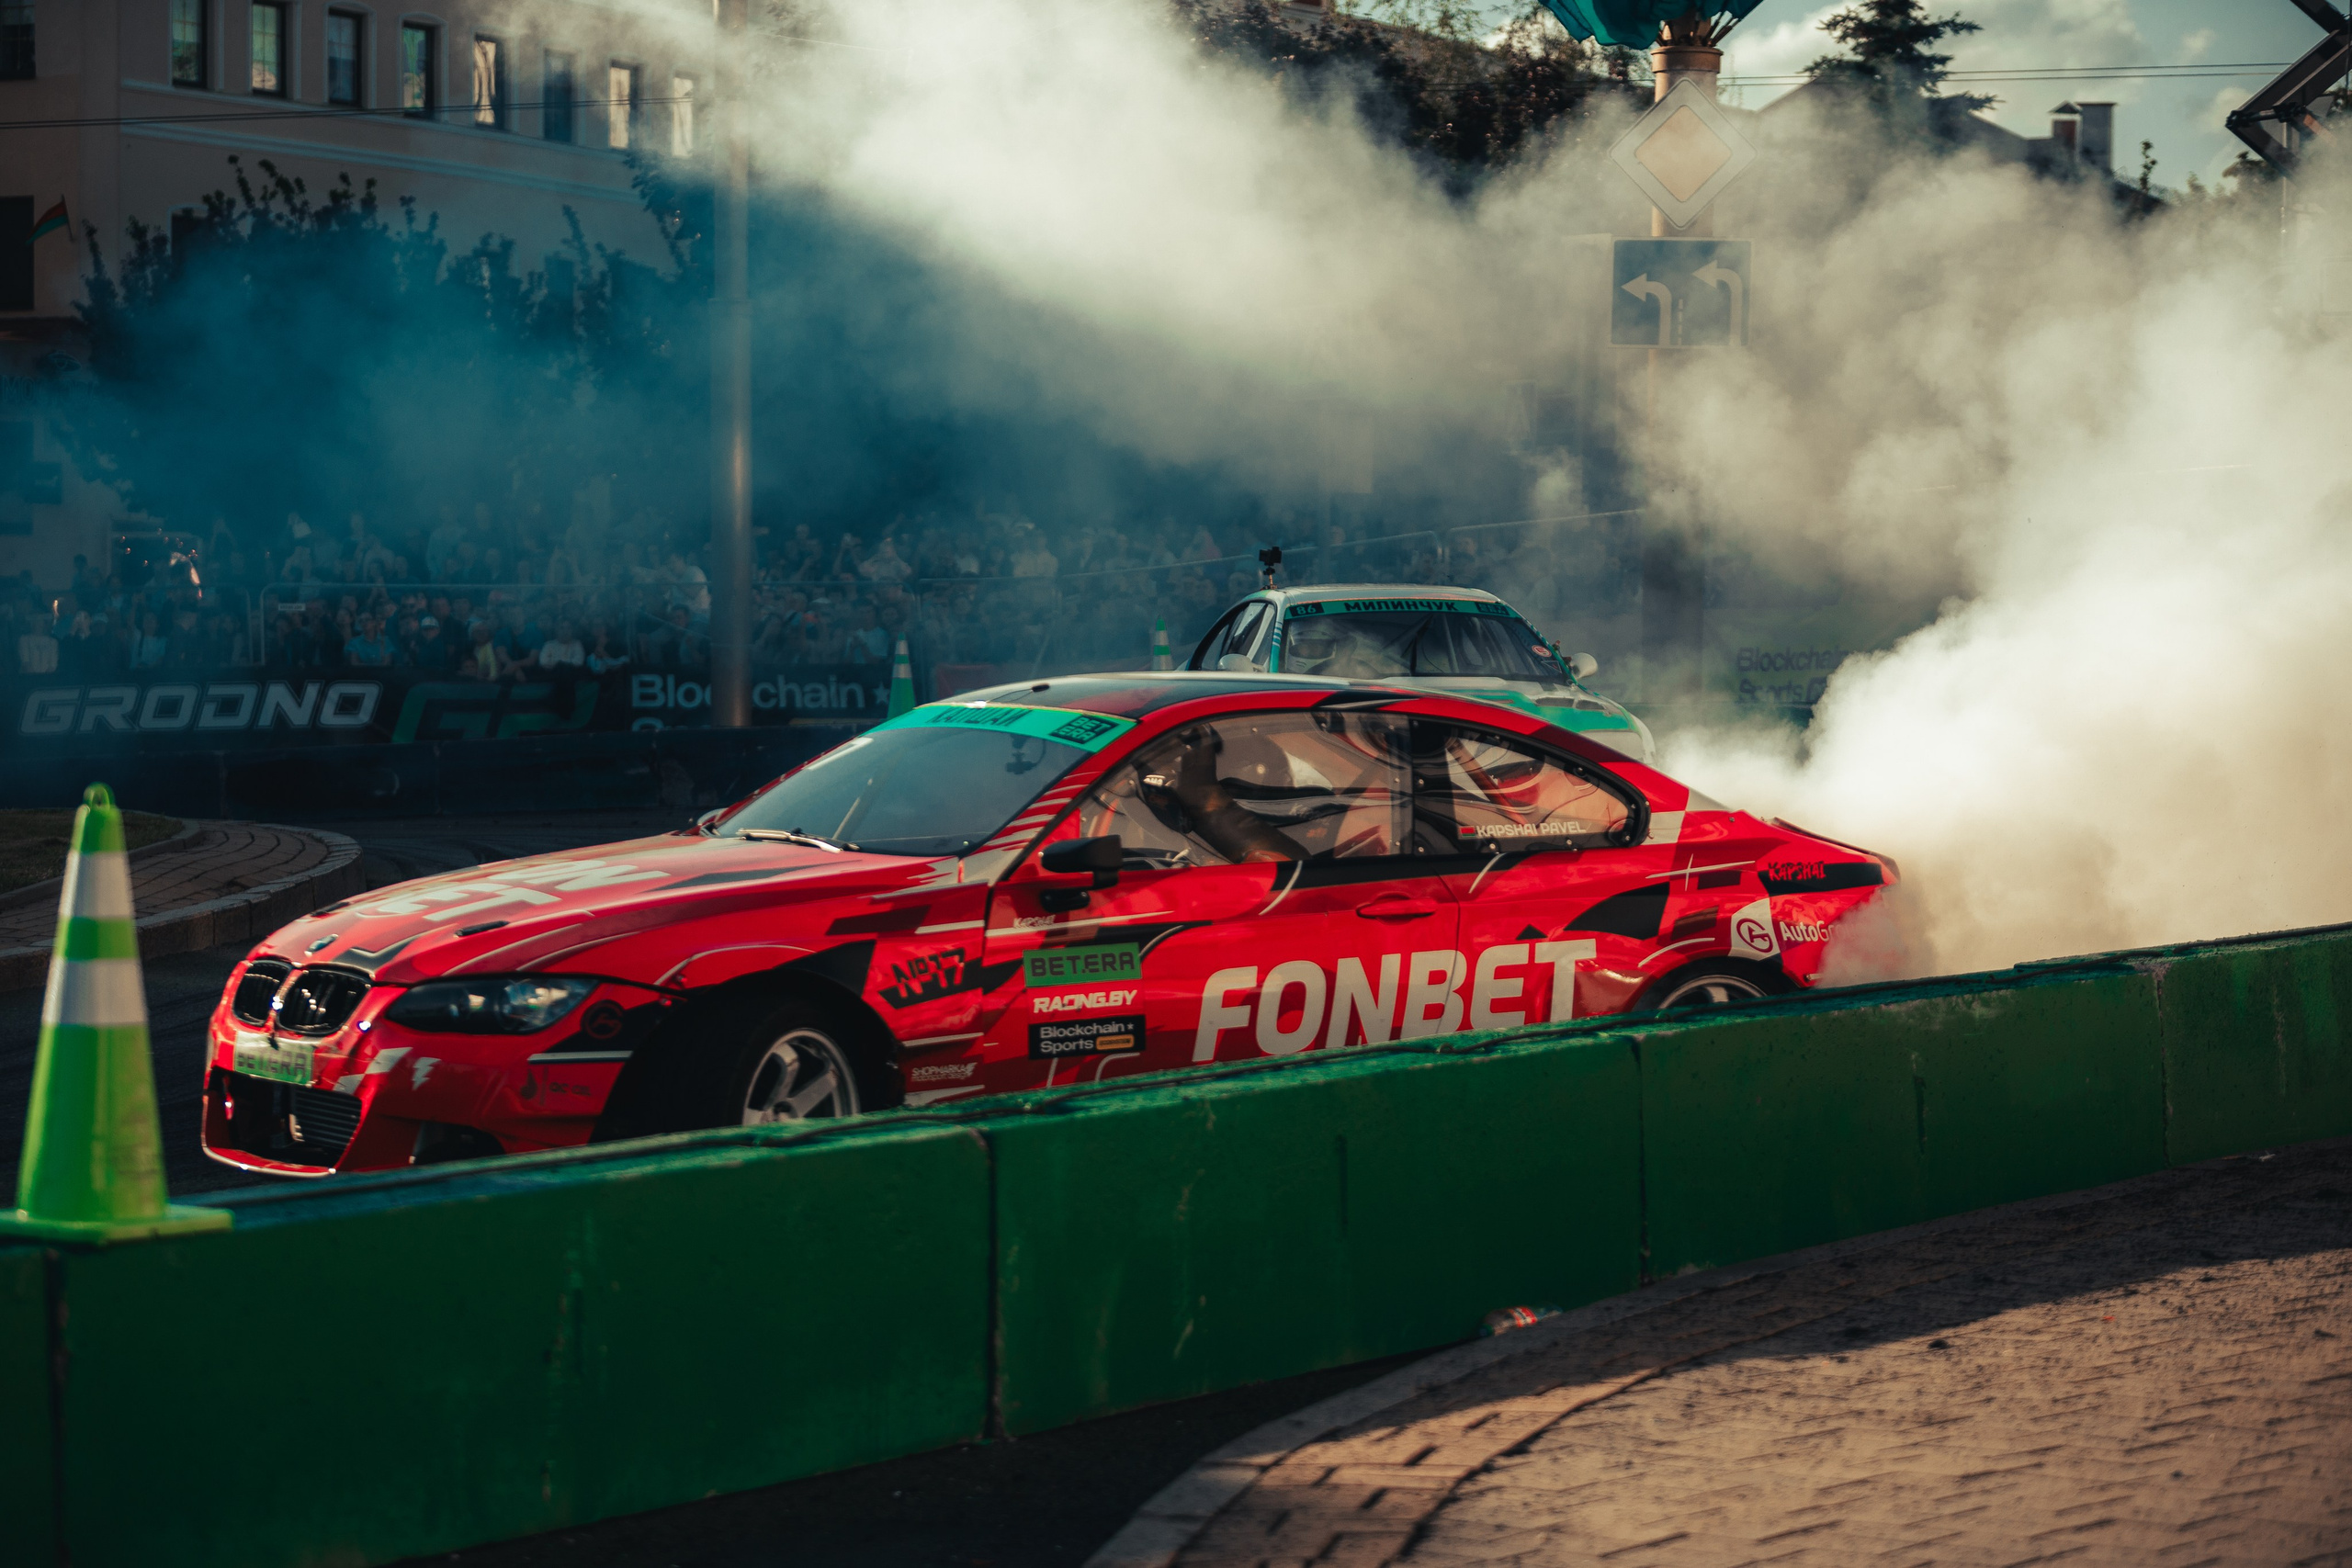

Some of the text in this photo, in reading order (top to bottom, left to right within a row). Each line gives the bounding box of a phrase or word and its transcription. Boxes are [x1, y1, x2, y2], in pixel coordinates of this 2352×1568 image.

[1296, 600, 1459, 615] 86 МИЛИНЧУК
[631, 674, 865, 709] Blochain
[19, 682, 381, 734] GRODNO
[1476, 821, 1587, 837] KAPSHAI PAVEL
[1767, 861, 1826, 882] KAPSHAI
[1192, 938, 1597, 1063] FONBET
[1040, 1021, 1125, 1039] Blockchain
[1040, 1039, 1094, 1054] Sports
